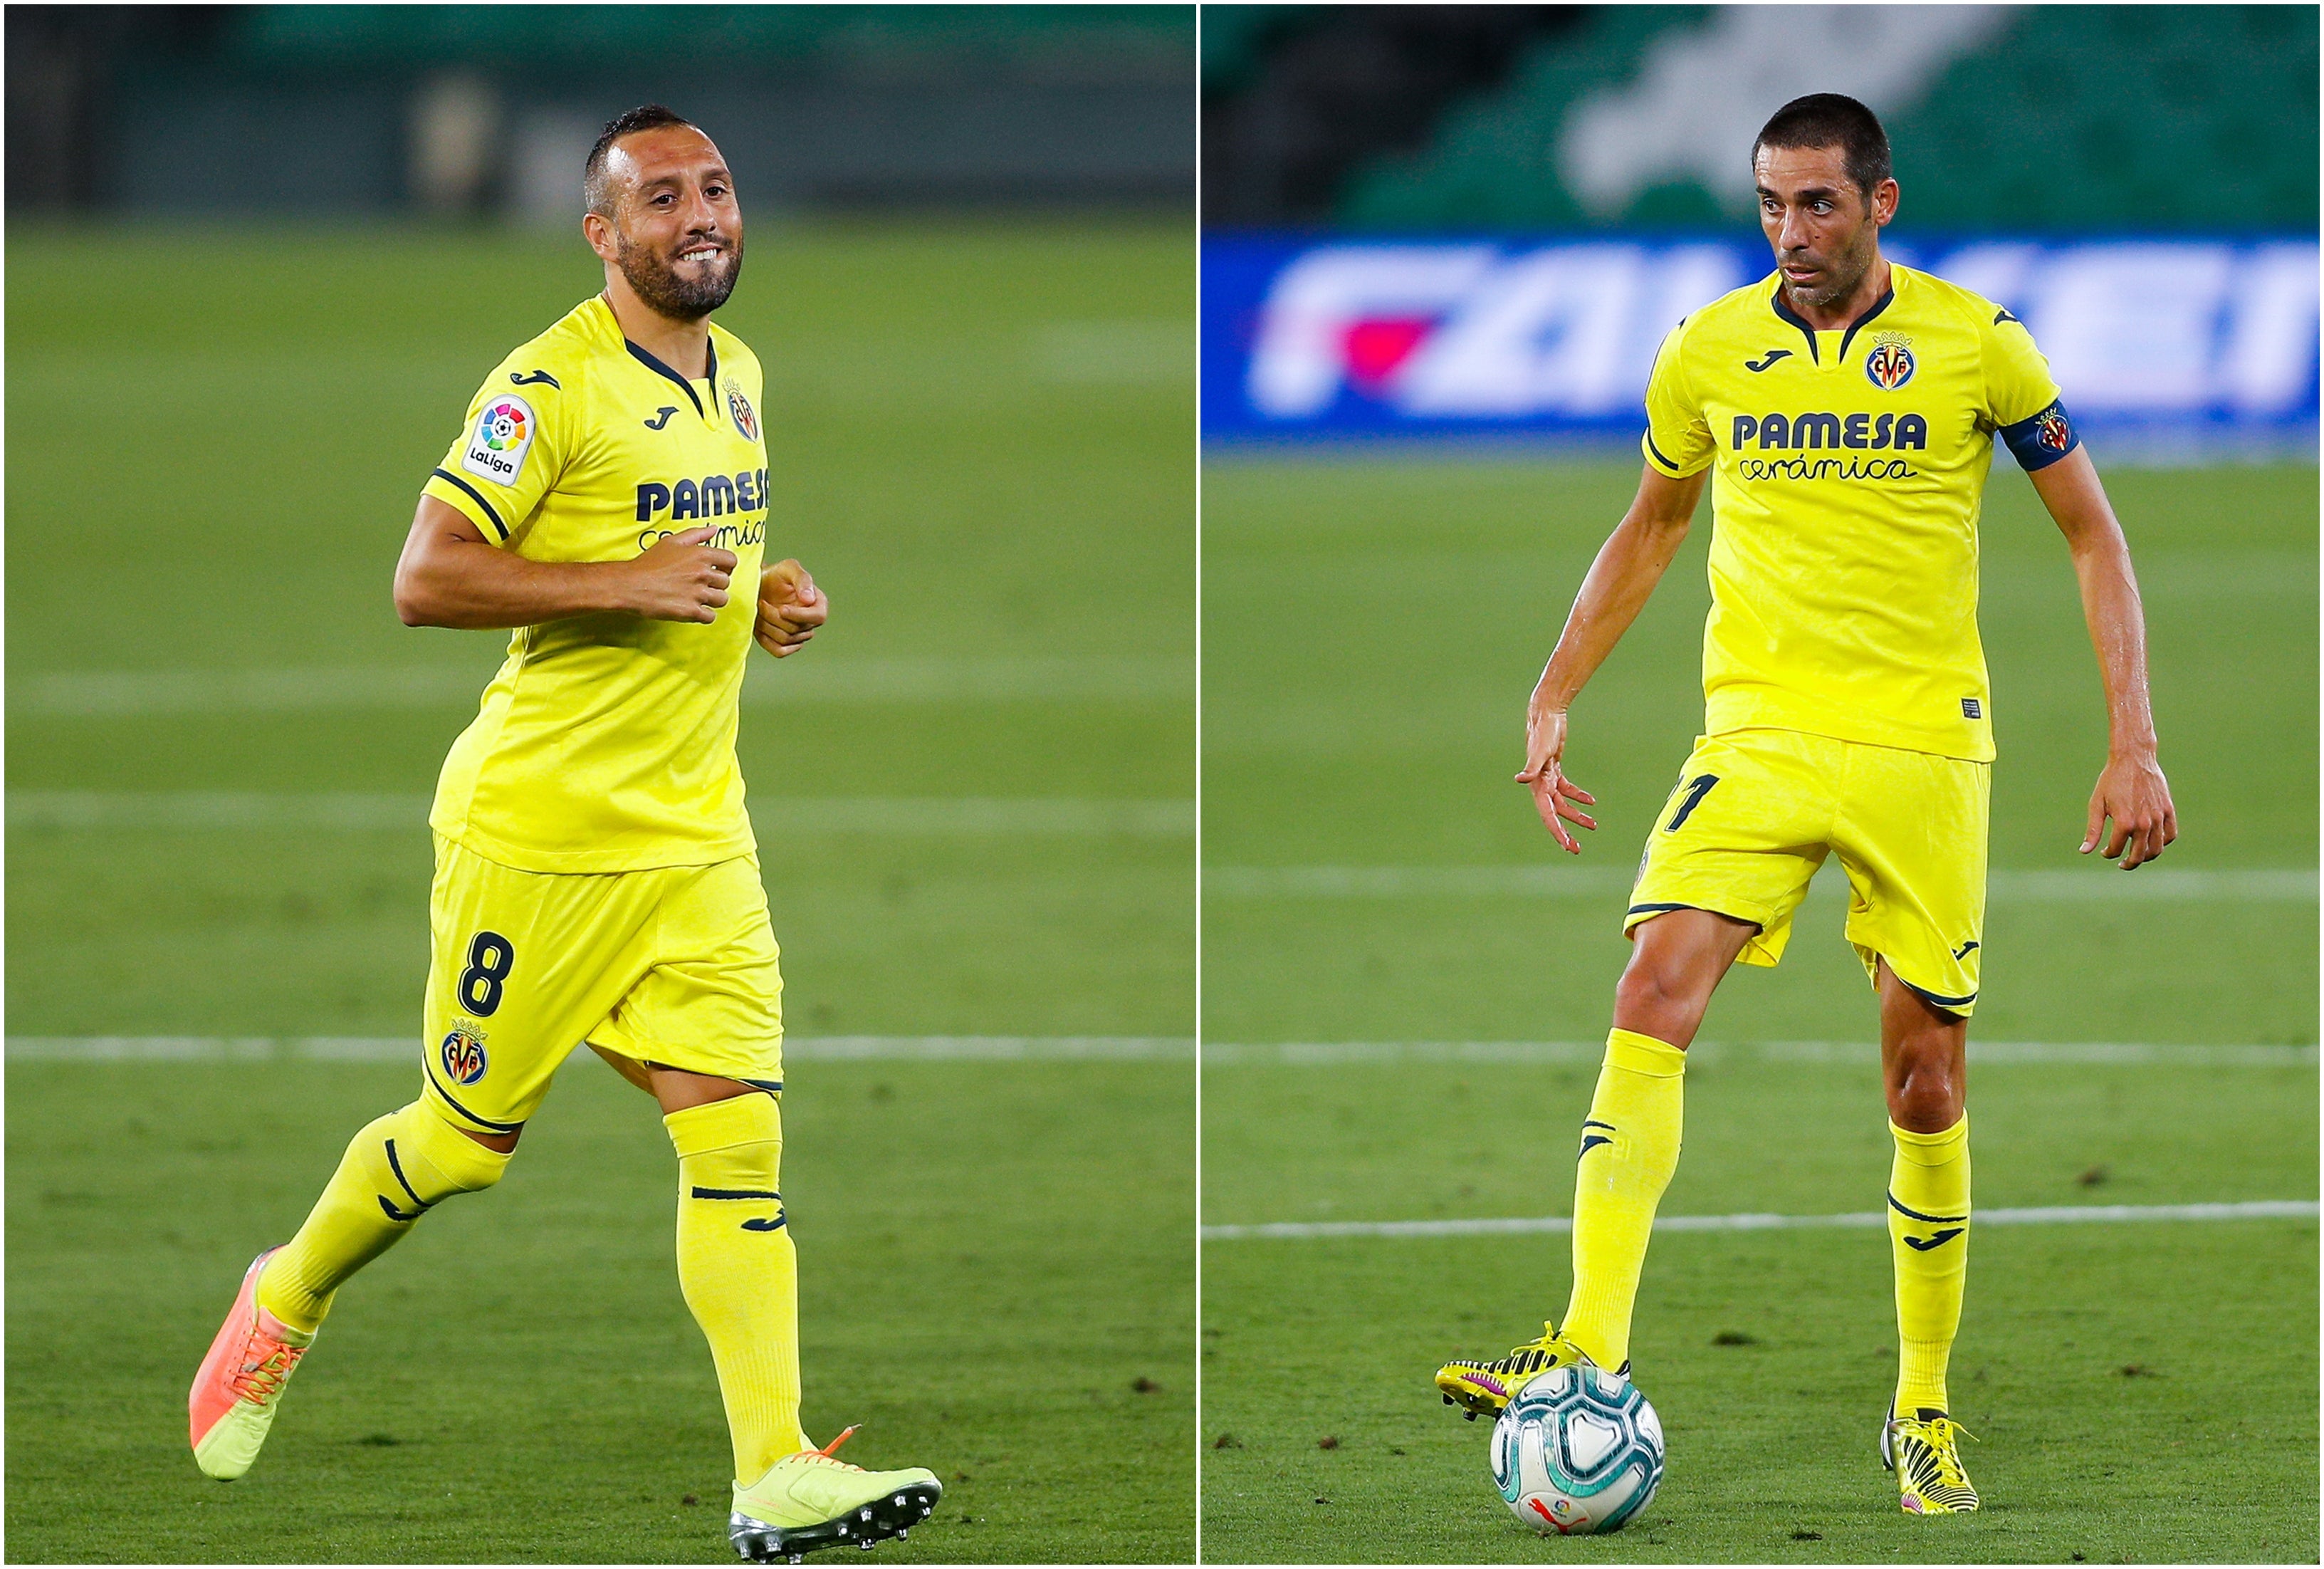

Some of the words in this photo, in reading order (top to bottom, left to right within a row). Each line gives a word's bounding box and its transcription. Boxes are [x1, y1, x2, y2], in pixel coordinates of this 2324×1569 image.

[1732, 412, 1927, 450] PAMESA
[470, 447, 513, 474] LaLiga
[1739, 453, 1918, 481] cerámica
[457, 931, 514, 1017] 8
